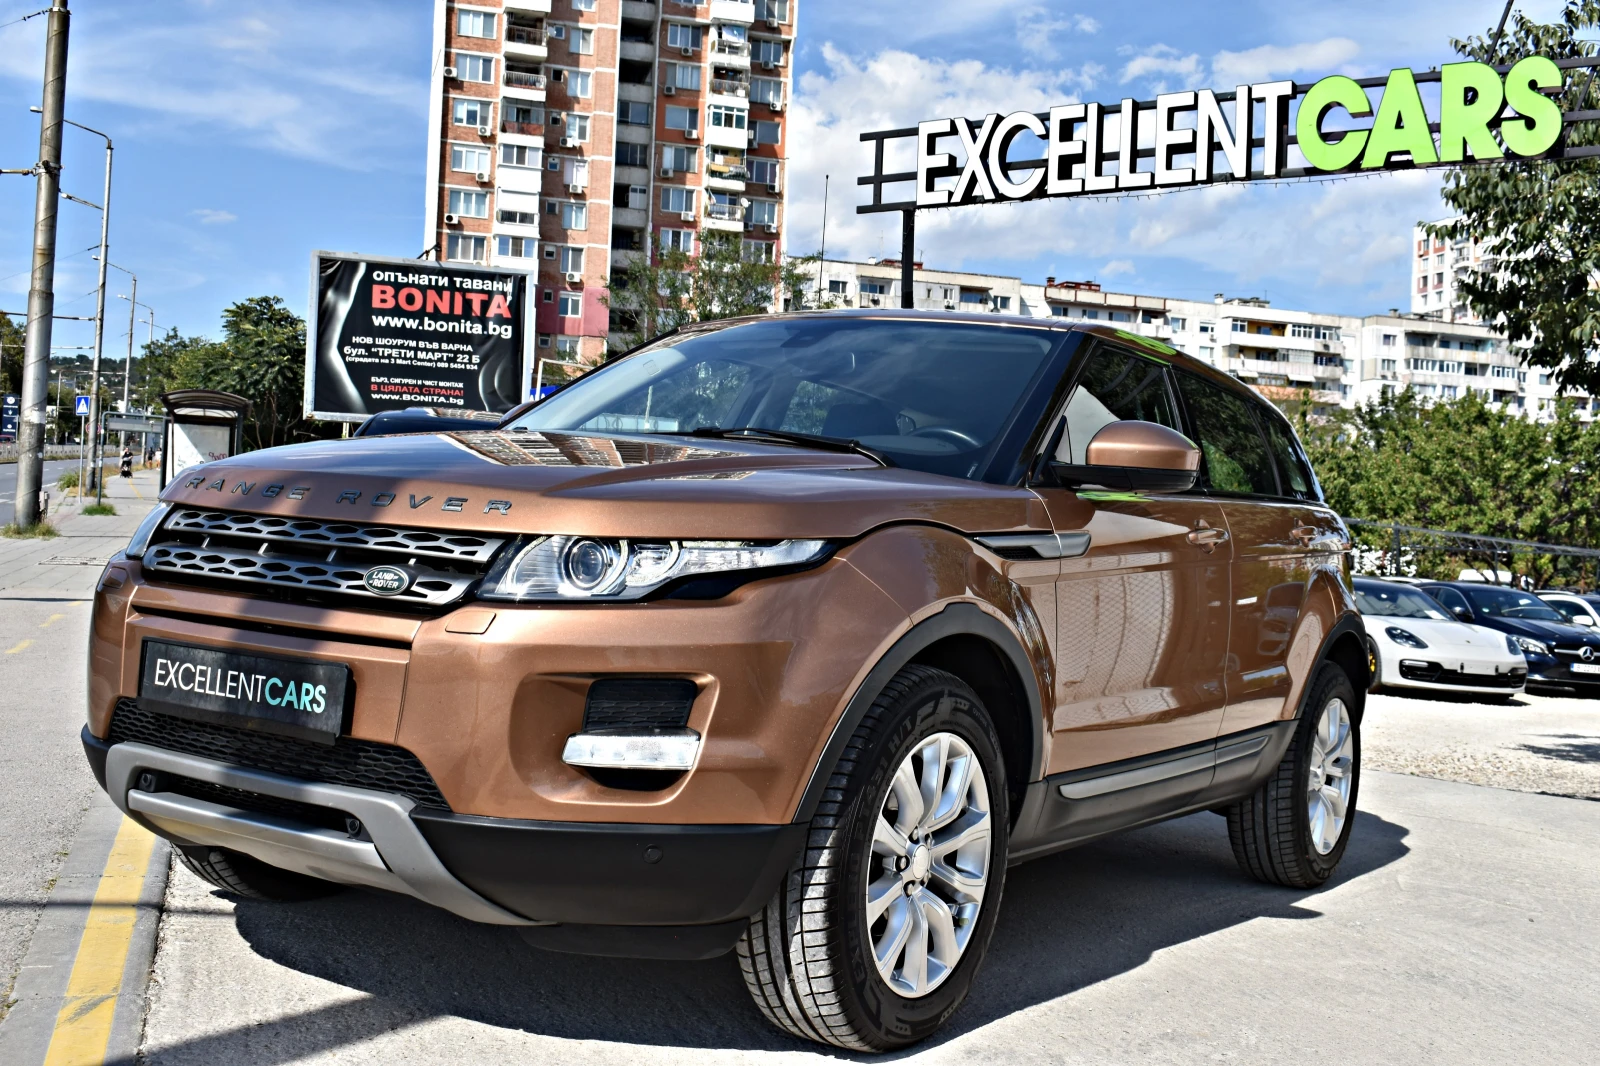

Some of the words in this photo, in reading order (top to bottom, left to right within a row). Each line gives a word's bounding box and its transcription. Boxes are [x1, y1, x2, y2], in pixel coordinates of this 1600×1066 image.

[372, 270, 448, 287] опънати
[454, 276, 512, 292] тавани
[372, 284, 512, 318] BONITA
[372, 316, 512, 339] www.bonita.bg
[352, 336, 373, 344] НОВ
[376, 338, 416, 347] ШОУРУМ
[418, 340, 439, 349] ВЪВ
[441, 343, 473, 352] ВАРНА
[344, 346, 368, 356] бул.
[456, 354, 469, 363] 22
[380, 385, 420, 393] ЦЯЛАТА
[422, 388, 464, 396] СТРАНА!
[371, 394, 464, 405] www.BONITA.bg
[185, 476, 312, 500] RANGE
[336, 488, 512, 516] ROVER
[372, 579, 399, 589] ROVER
